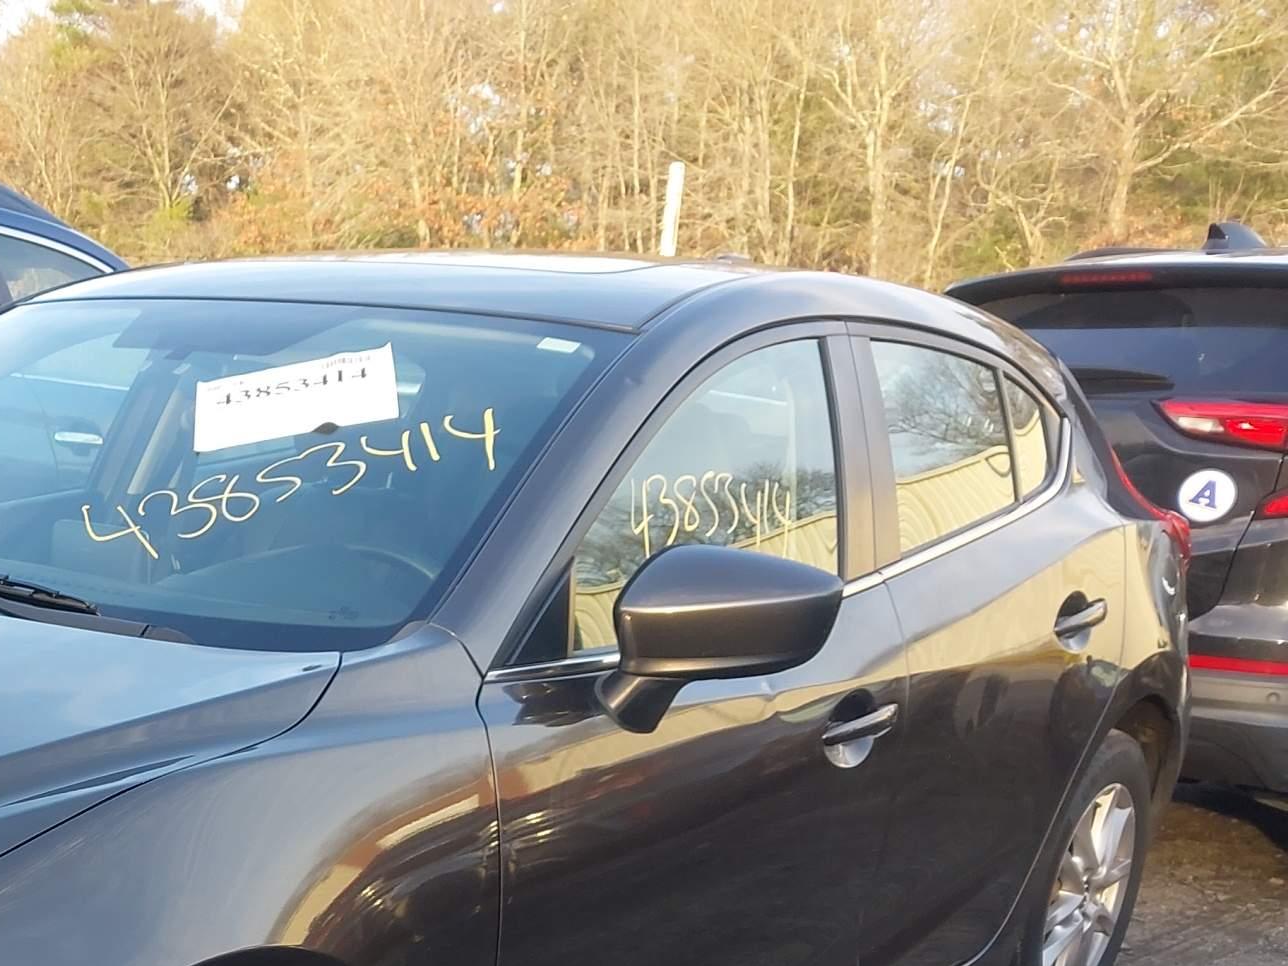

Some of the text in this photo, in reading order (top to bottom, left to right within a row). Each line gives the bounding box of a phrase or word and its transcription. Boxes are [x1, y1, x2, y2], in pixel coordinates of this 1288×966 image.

[216, 367, 368, 406] 43853414
[82, 407, 500, 560] 43853414
[630, 470, 792, 560] 43853414
[1188, 479, 1217, 510] A
